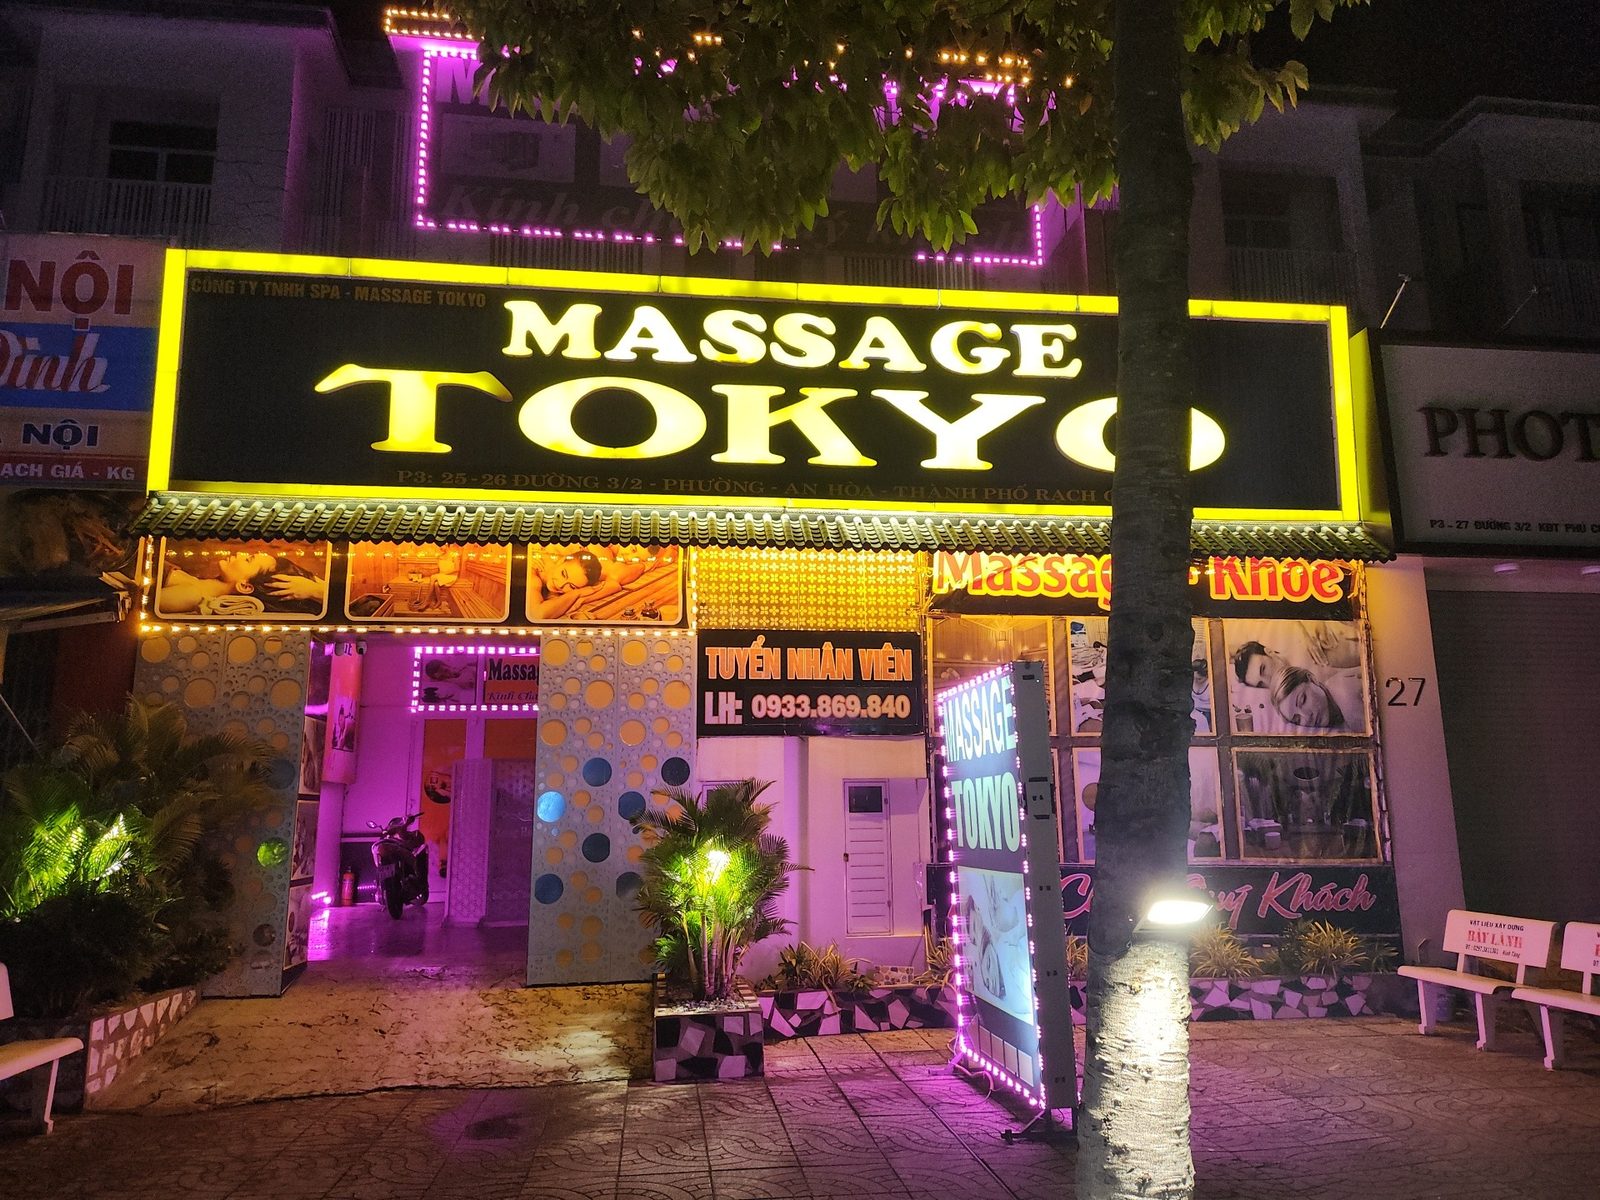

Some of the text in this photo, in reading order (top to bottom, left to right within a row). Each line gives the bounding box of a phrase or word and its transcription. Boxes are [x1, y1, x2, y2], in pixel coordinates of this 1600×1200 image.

[239, 279, 259, 296] TY
[263, 281, 305, 298] TNHH
[310, 283, 341, 299] SPA
[354, 286, 432, 305] MASSAGE
[437, 289, 487, 308] TOKYO
[502, 300, 1082, 378] MASSAGE
[22, 418, 98, 450] NỘI
[314, 364, 1226, 473] TOKYO
[51, 461, 84, 479] GIÁ
[107, 467, 135, 480] KG
[607, 476, 643, 490] 3/2
[663, 476, 765, 494] PHƯỜNG
[785, 482, 818, 496] AN
[828, 480, 875, 497] HÒA
[893, 483, 977, 499] THÀNH
[983, 483, 1029, 500] PHỐ
[1456, 520, 1469, 530] 27
[705, 635, 912, 681] TUYỂN NHÂN VIÊN
[705, 691, 911, 725] LH: 0933.869.840
[1385, 677, 1426, 706] 27
[944, 675, 1017, 762] MASSAGE
[951, 771, 1020, 852] TOKYO
[1257, 871, 1376, 919] Khách
